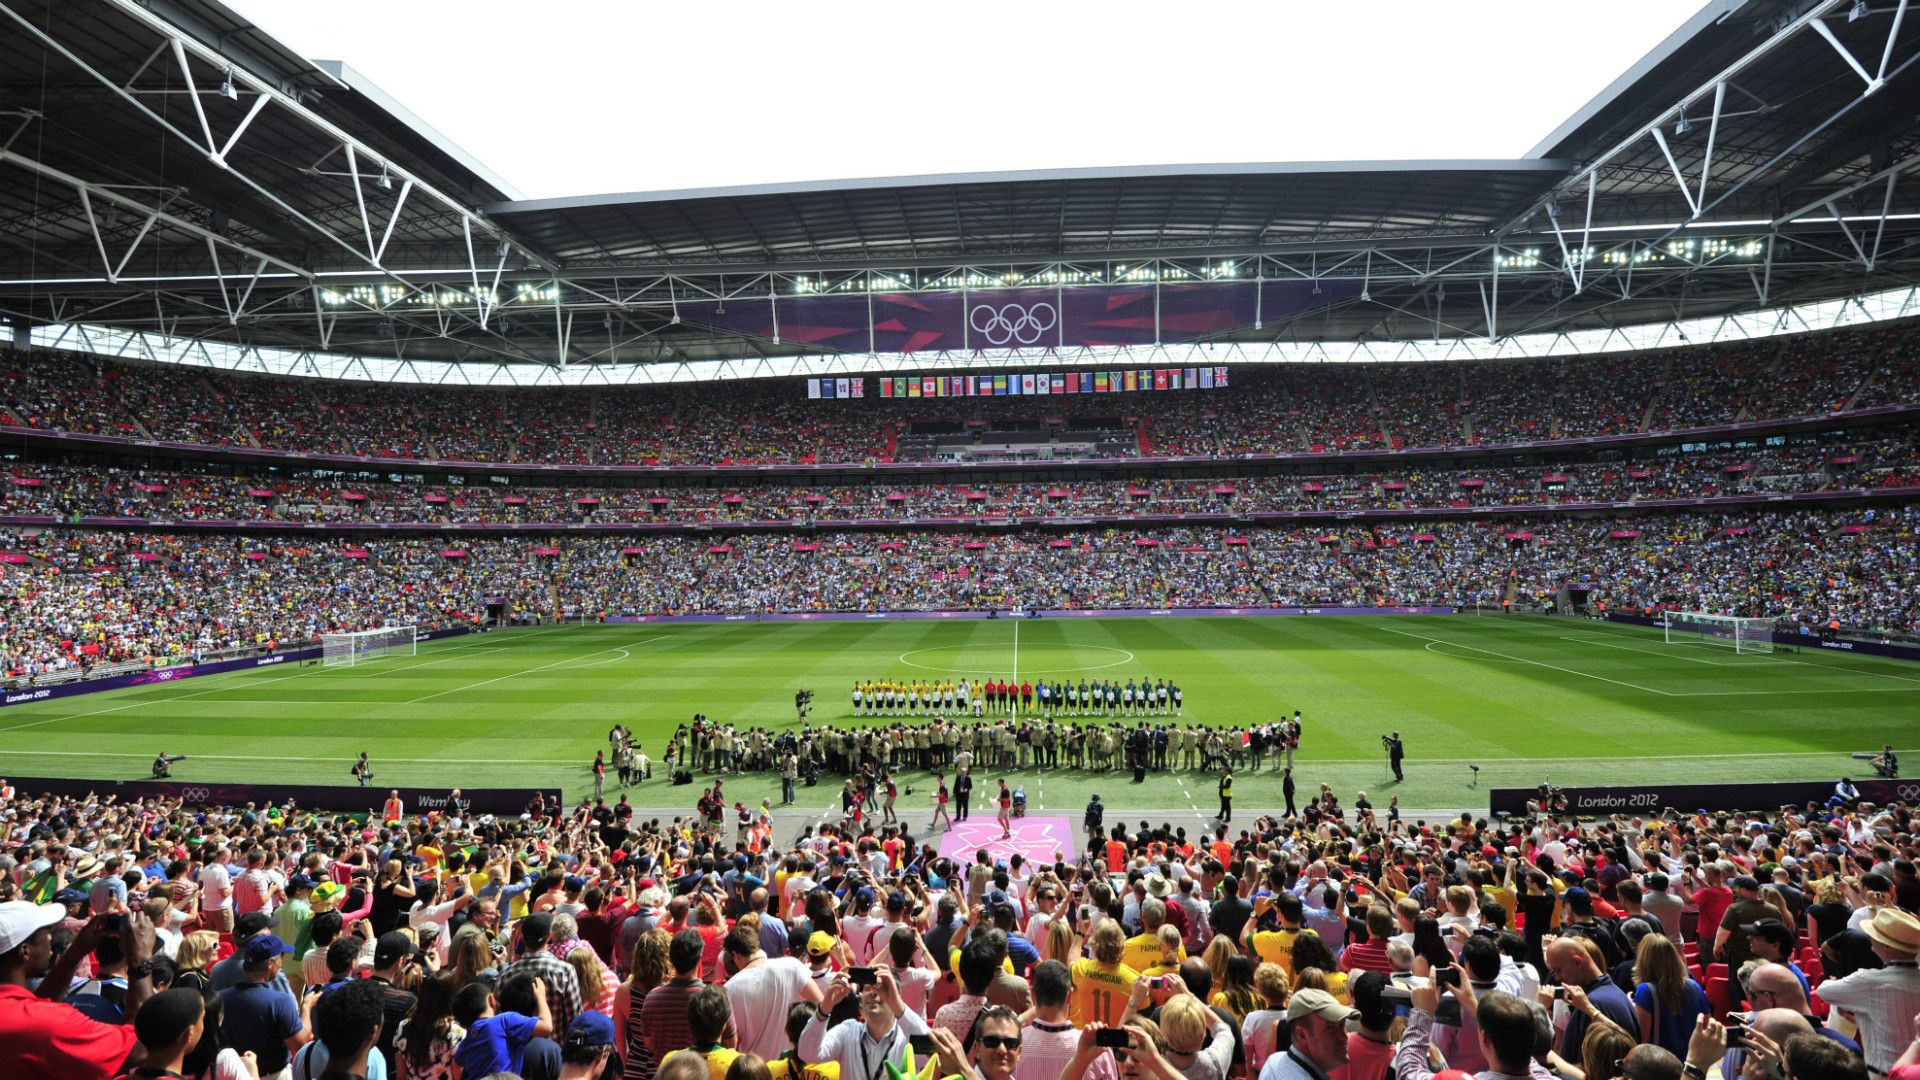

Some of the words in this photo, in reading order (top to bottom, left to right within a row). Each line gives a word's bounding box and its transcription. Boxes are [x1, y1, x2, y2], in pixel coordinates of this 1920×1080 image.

[6, 693, 33, 702] London
[34, 690, 50, 698] 2012
[1577, 794, 1626, 807] London
[1629, 793, 1659, 806] 2012
[735, 886, 745, 903] 4
[1085, 969, 1122, 985] PARMIGIANI
[1093, 988, 1111, 1026] 11
